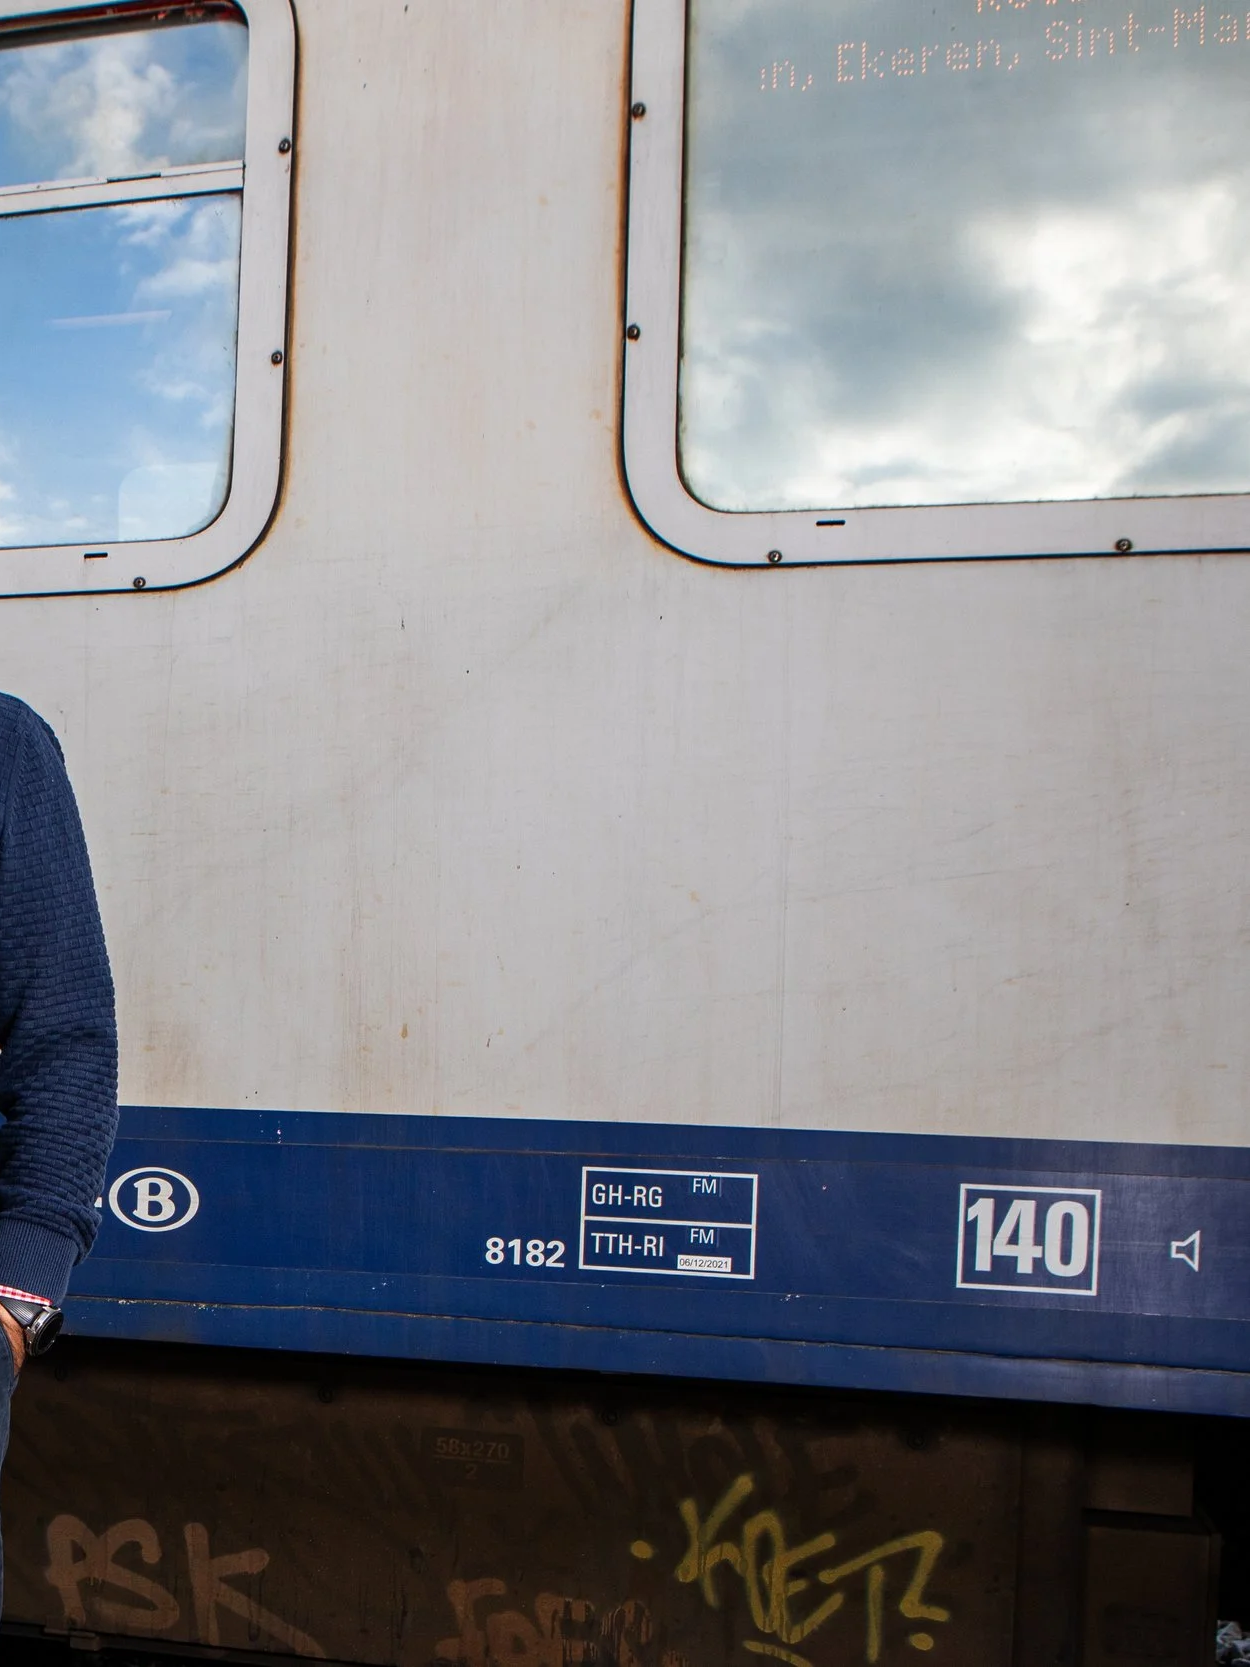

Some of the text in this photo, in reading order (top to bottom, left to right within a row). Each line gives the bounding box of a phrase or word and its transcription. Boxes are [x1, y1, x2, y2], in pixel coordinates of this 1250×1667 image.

[837, 38, 1019, 82] Ekeren,
[592, 1178, 718, 1208] GH-RG FM
[485, 1237, 566, 1268] 8182
[590, 1228, 715, 1257] TTH-RI FM
[967, 1197, 1089, 1278] 140
[678, 1257, 729, 1270] 06/12/2021
